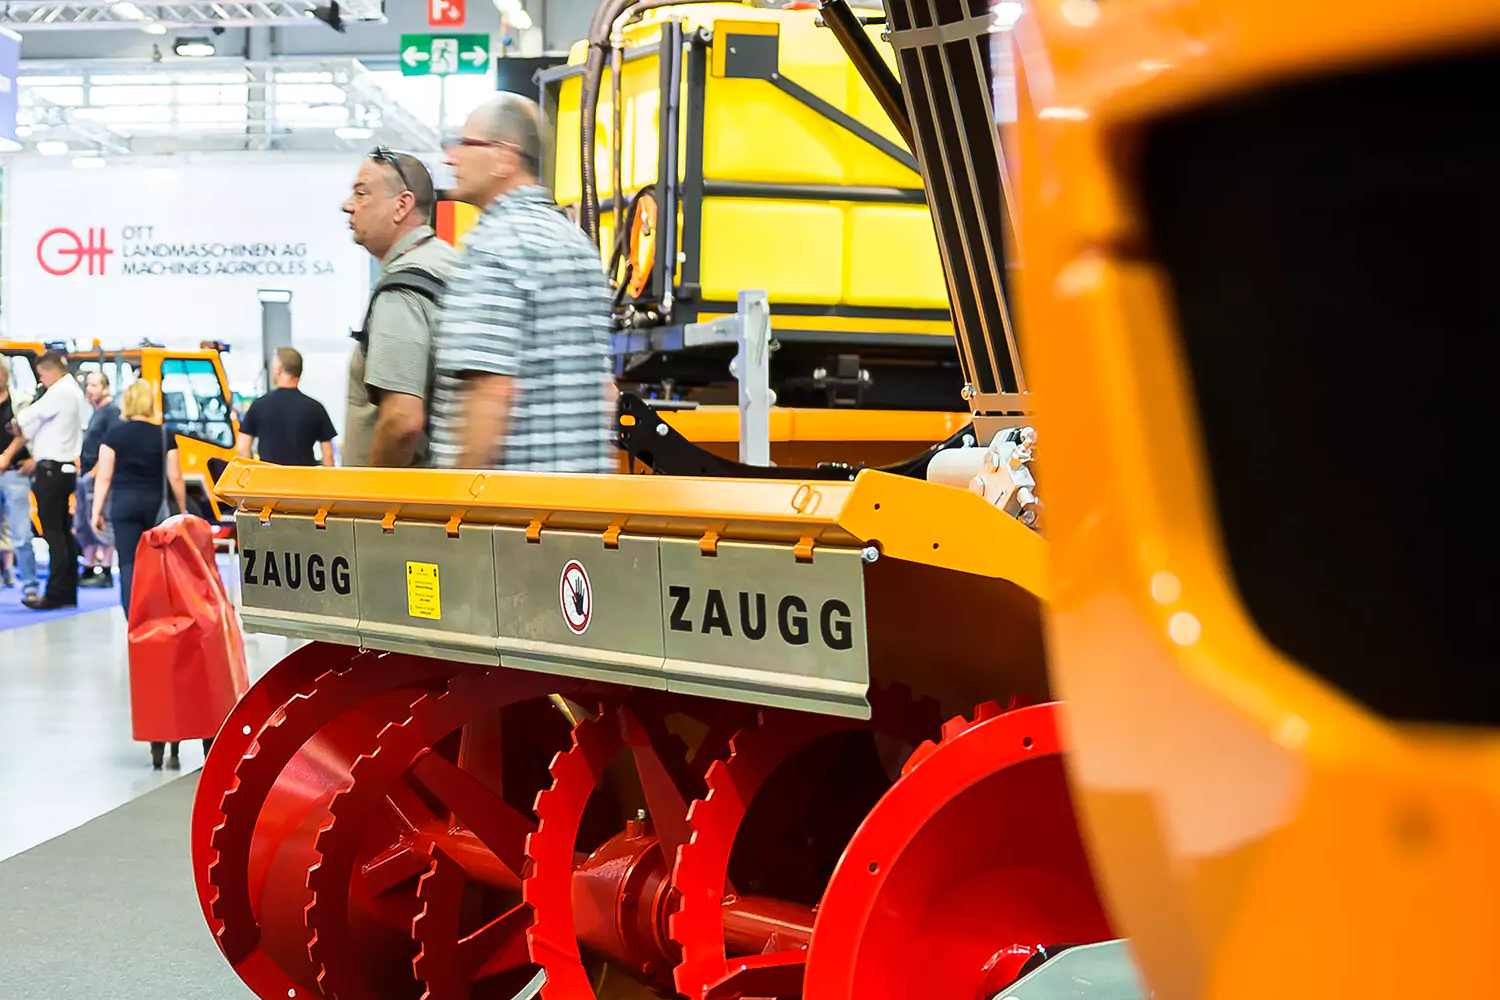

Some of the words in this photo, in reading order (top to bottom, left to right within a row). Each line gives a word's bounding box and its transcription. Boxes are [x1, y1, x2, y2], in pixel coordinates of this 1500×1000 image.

[122, 226, 154, 240] OTT
[122, 243, 277, 257] LANDMASCHINEN
[282, 243, 307, 257] AG
[122, 260, 212, 275] MACHINES
[215, 260, 307, 275] AGRICOLES
[313, 260, 336, 275] SA
[243, 549, 351, 595] ZAUGG
[668, 585, 853, 651] ZAUGG
